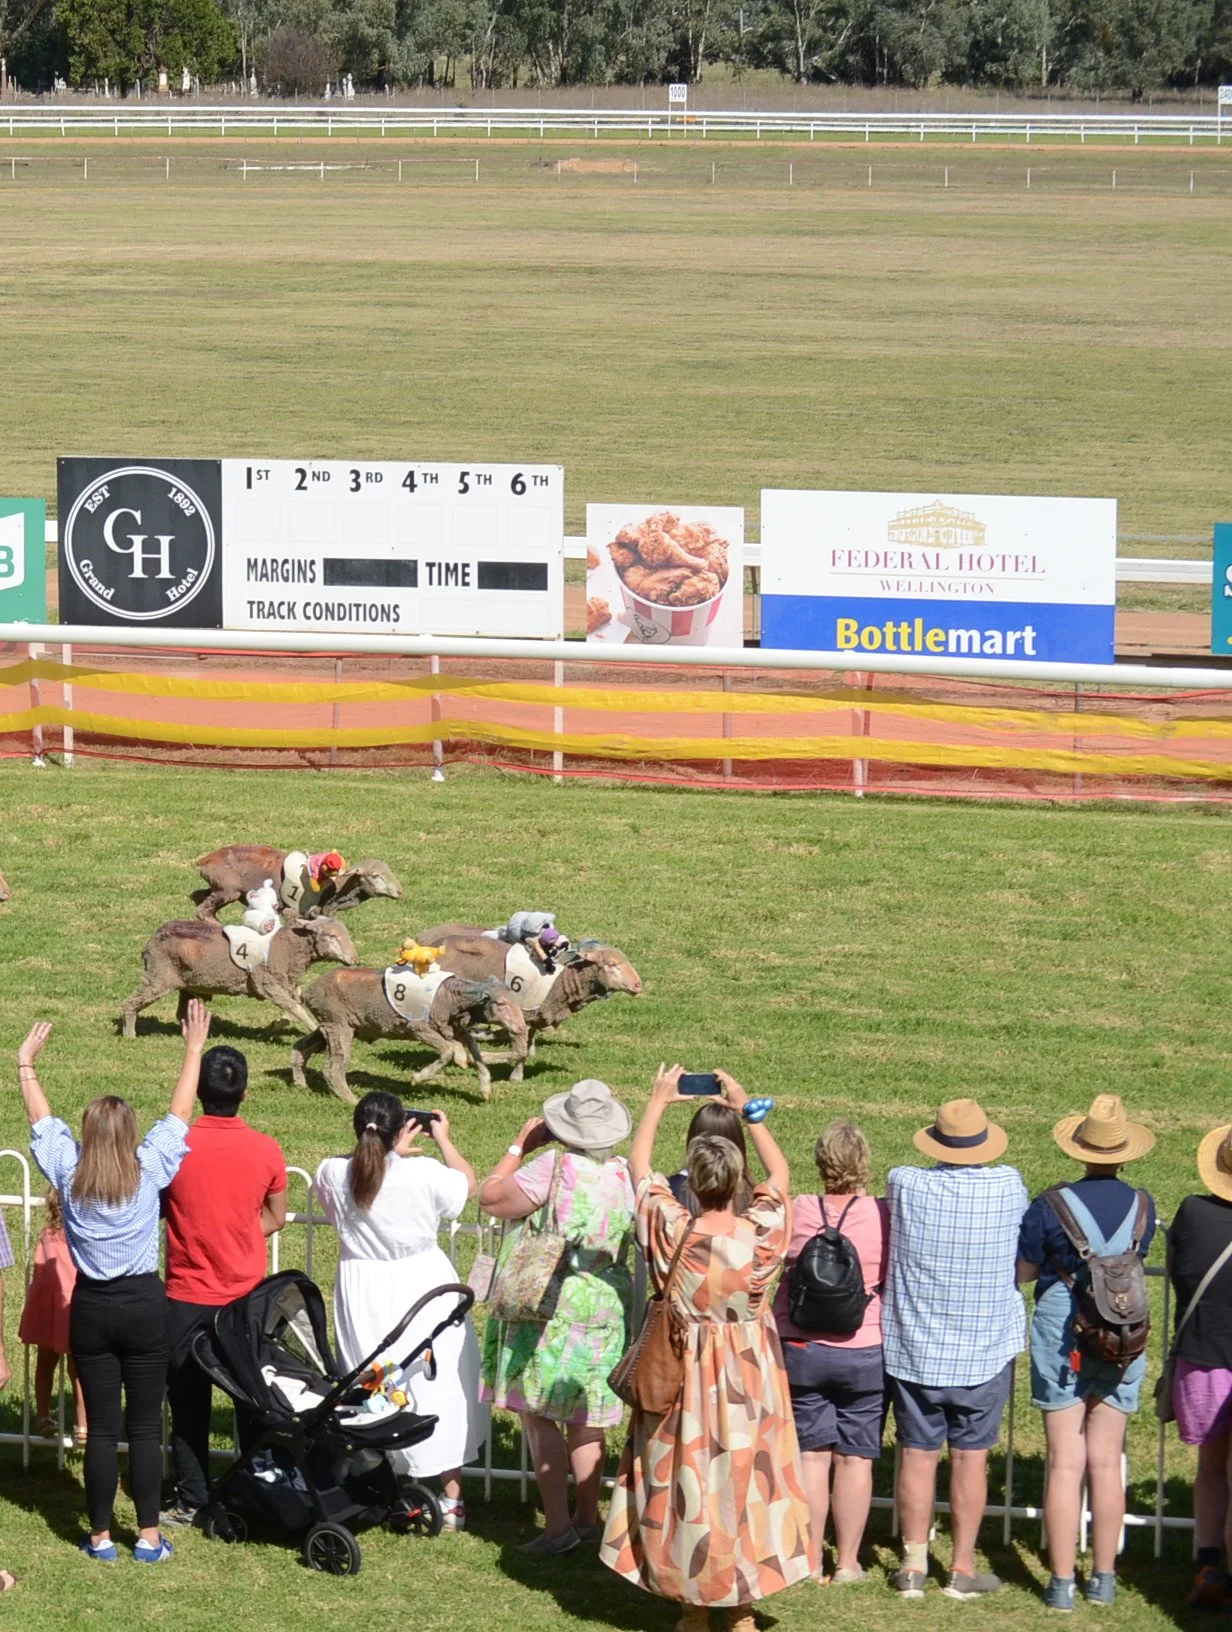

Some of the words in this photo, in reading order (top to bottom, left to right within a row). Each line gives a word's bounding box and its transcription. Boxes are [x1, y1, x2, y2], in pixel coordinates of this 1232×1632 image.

[670, 85, 686, 98] 1000
[245, 466, 271, 490] 1ST
[294, 467, 332, 491] 2ND
[348, 469, 384, 493] 3RD
[400, 470, 440, 494] 4TH
[458, 471, 493, 495] 5TH
[510, 472, 550, 496] 6TH
[84, 485, 111, 514] EST
[167, 486, 196, 517] 1892
[246, 557, 317, 585] MARGINS
[425, 561, 472, 587] TIME
[831, 549, 950, 572] FEDERAL
[958, 552, 1047, 575] HOTEL
[79, 559, 116, 601] Grand
[165, 567, 199, 602] Hotel
[880, 579, 996, 595] WELLINGTON
[246, 600, 298, 621] TRACK
[302, 601, 401, 624] CONDITIONS
[836, 617, 1037, 656] Bottlemart
[287, 884, 300, 902] 1
[234, 942, 249, 961] 4
[392, 982, 407, 1002] 8
[509, 974, 525, 994] 6
